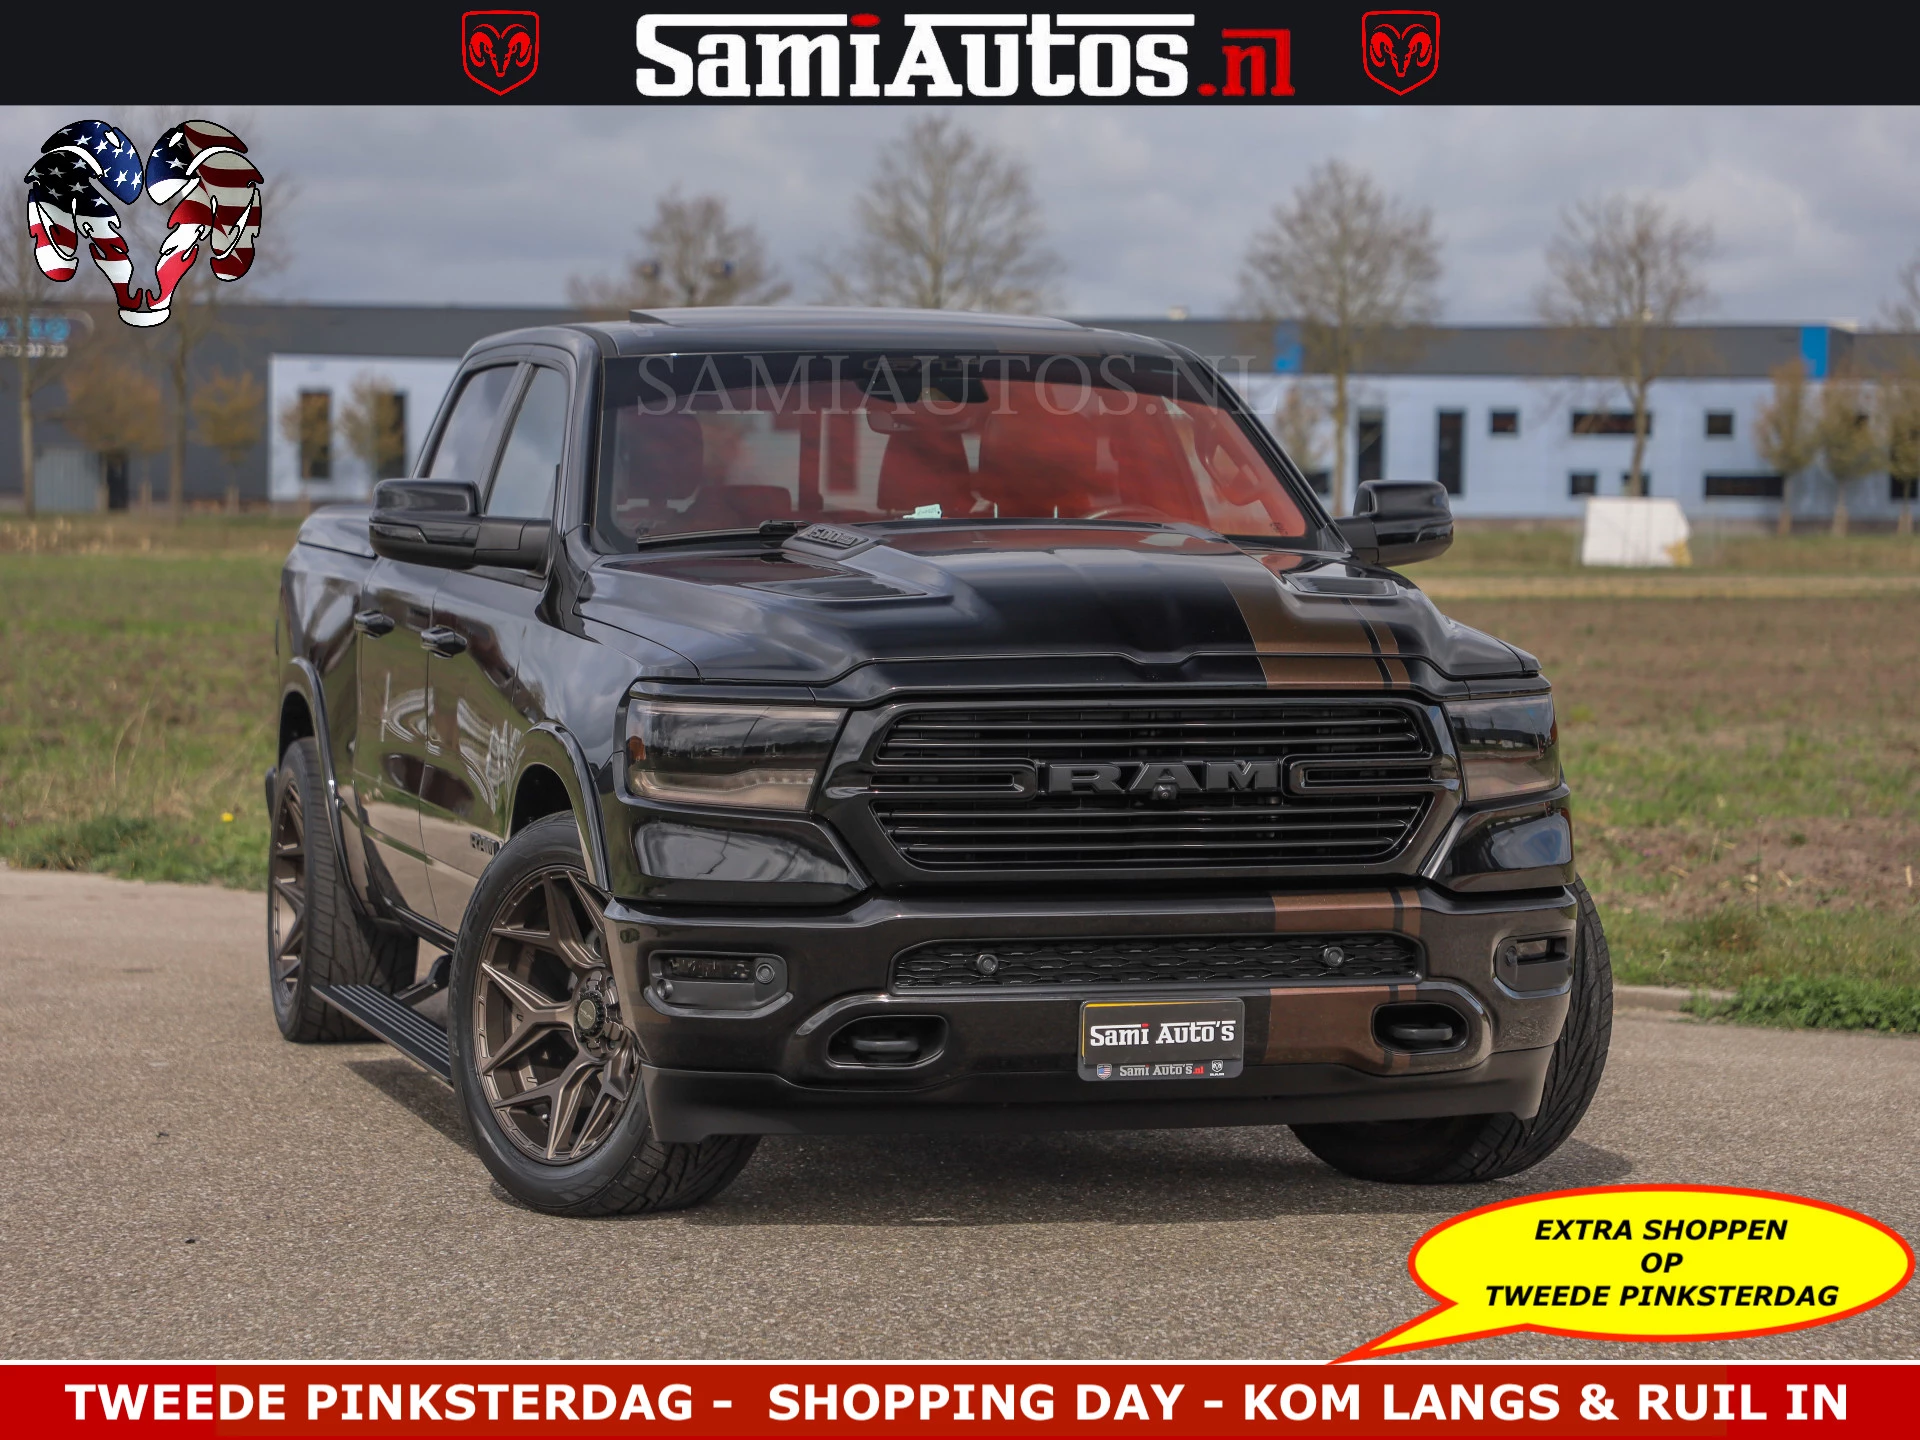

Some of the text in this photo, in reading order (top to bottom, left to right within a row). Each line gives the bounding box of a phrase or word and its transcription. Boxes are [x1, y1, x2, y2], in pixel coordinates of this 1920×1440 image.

[1049, 760, 1279, 793] RAM
[470, 832, 499, 856] RAM
[1090, 1020, 1236, 1047] Sami Auto's
[1119, 1063, 1150, 1077] Sami
